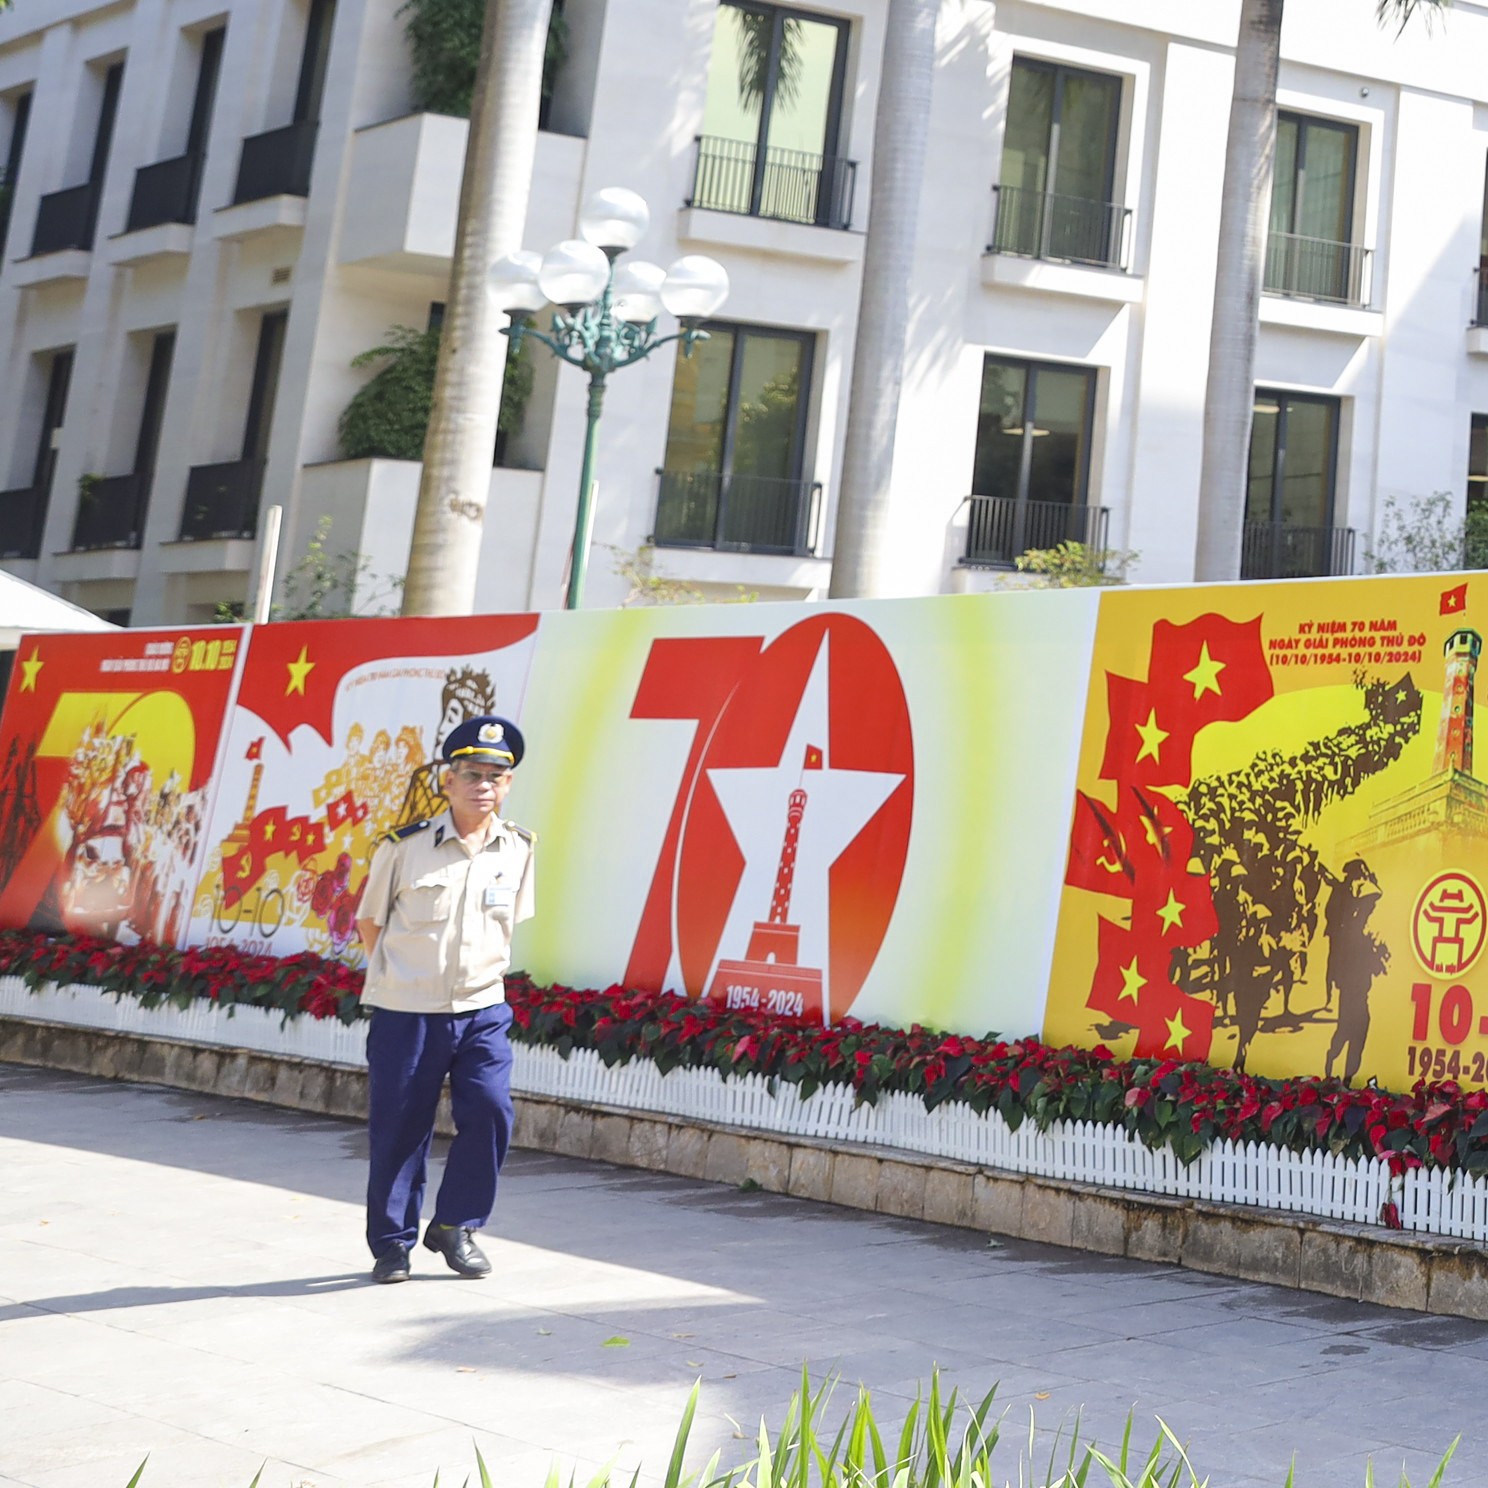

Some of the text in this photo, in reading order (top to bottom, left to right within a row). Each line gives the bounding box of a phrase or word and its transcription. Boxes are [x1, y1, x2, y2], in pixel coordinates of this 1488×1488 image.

[1350, 621, 1366, 633] 70
[1269, 649, 1422, 666] (10/10/1954-10/10/2024)
[621, 611, 915, 1028] 70
[208, 883, 285, 939] 10-10
[207, 935, 273, 957] 192024
[726, 984, 804, 1018] 1954-2024
